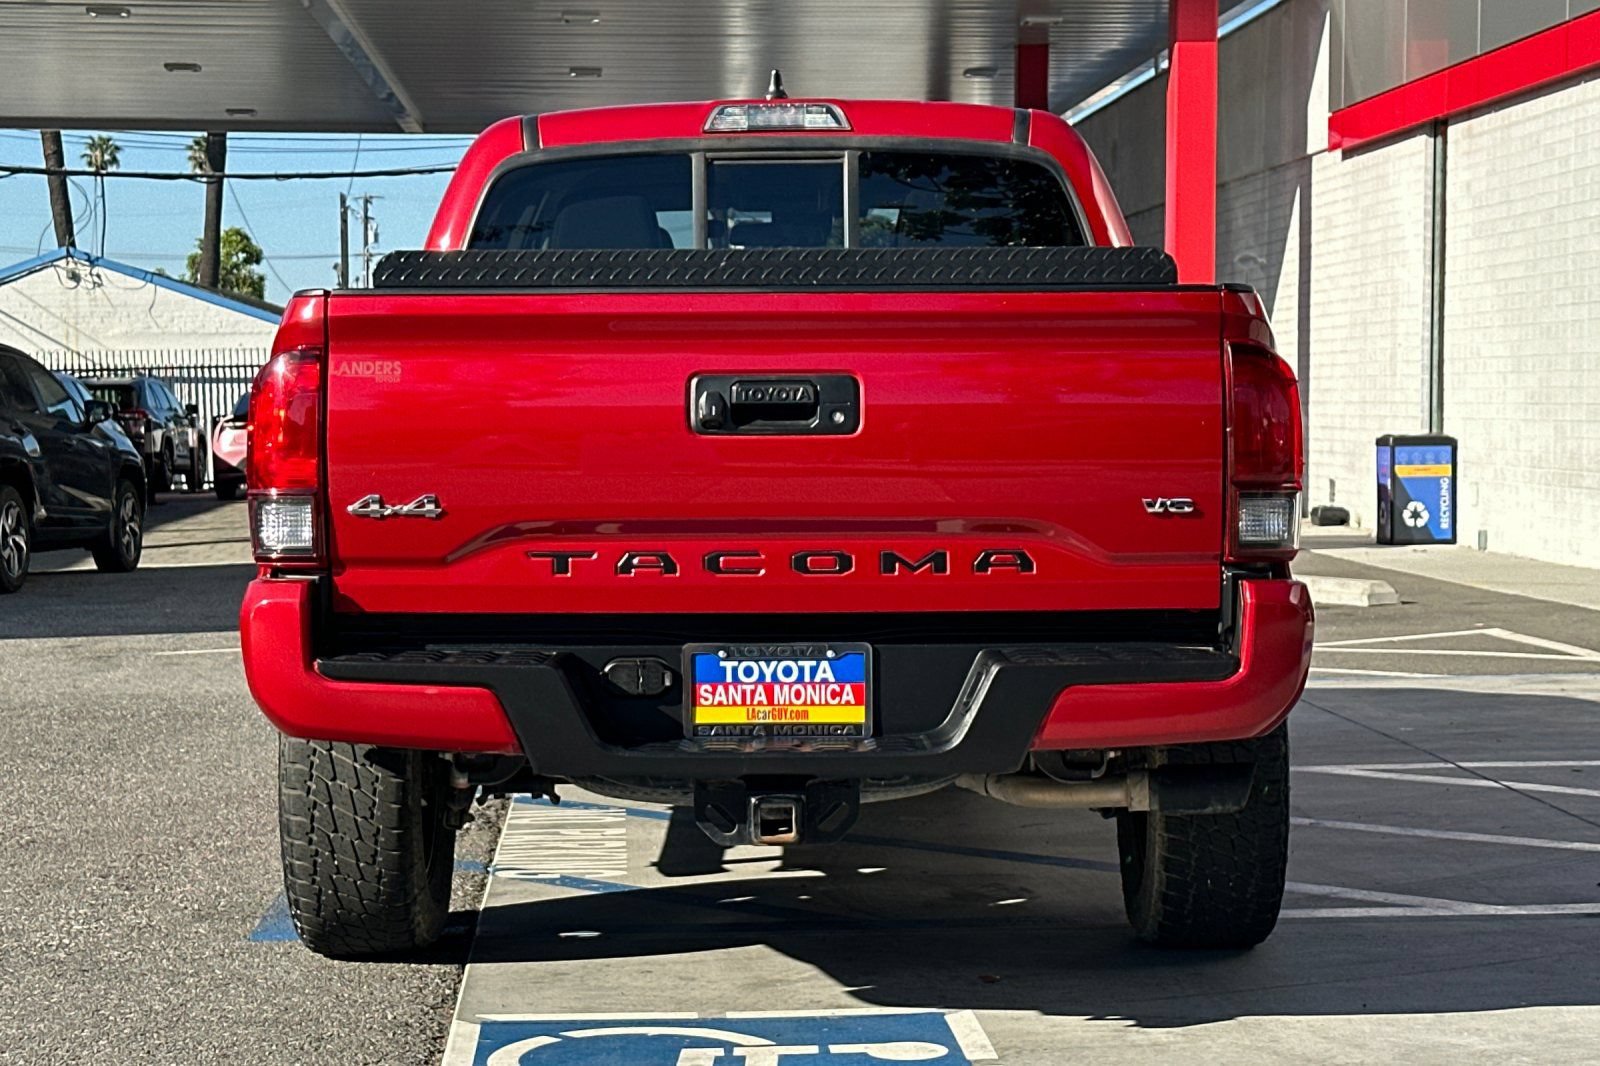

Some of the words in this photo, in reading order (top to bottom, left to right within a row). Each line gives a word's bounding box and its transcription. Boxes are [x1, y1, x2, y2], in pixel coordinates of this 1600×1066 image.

[330, 361, 402, 375] LANDERS
[738, 387, 811, 401] TOYOTA
[1141, 497, 1194, 513] V6
[1440, 477, 1449, 529] RECYCLING
[526, 548, 1038, 577] TACOMA
[729, 645, 822, 657] TOYOTA
[719, 660, 836, 683] TOYOTA
[700, 684, 768, 706] SANTA
[773, 684, 856, 705] MONICA
[746, 707, 809, 721] LAcarGUY.com
[698, 725, 766, 736] SANTA
[773, 725, 857, 736] MONICA
